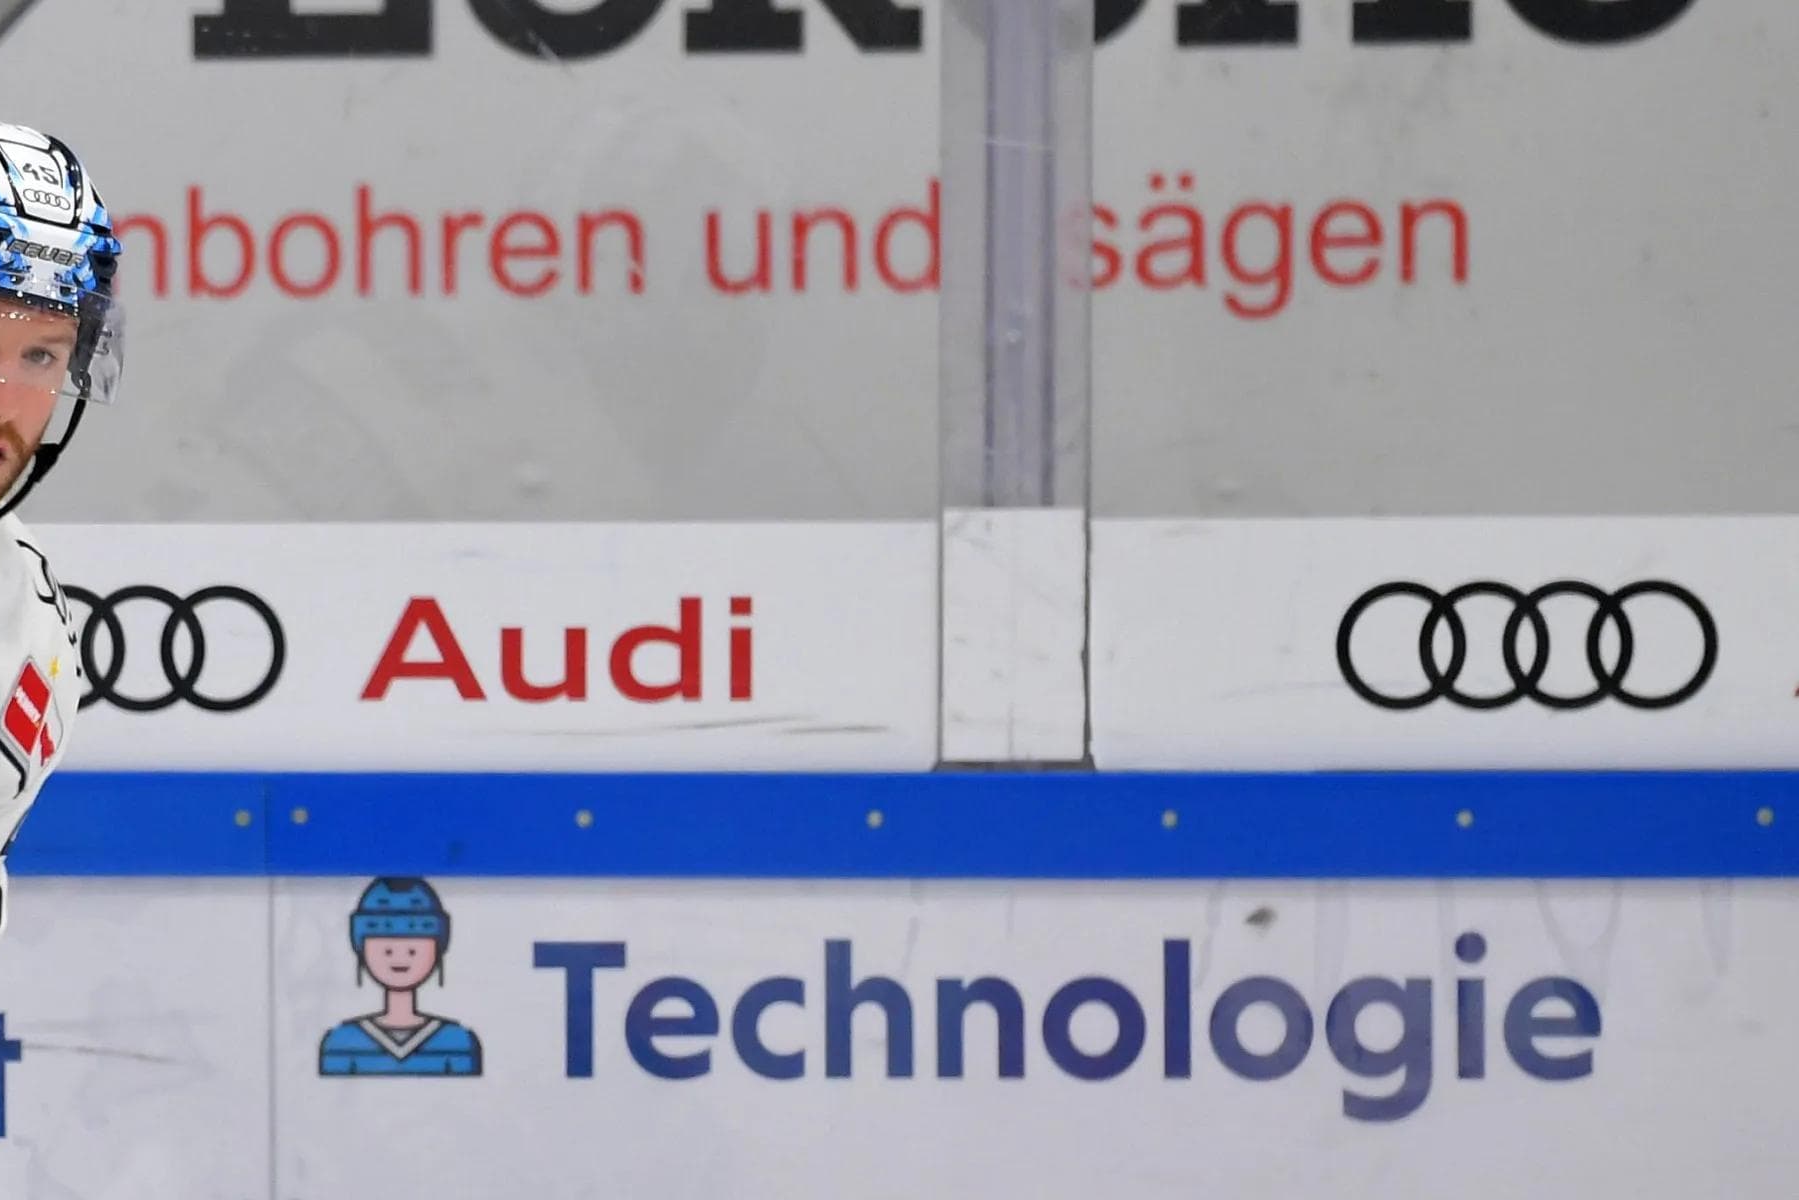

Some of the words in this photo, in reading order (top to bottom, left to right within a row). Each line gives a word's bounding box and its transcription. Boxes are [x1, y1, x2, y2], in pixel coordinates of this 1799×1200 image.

[22, 162, 60, 185] 45
[705, 181, 942, 296] und
[360, 596, 753, 703] Audi
[532, 932, 1603, 1123] Technologie
